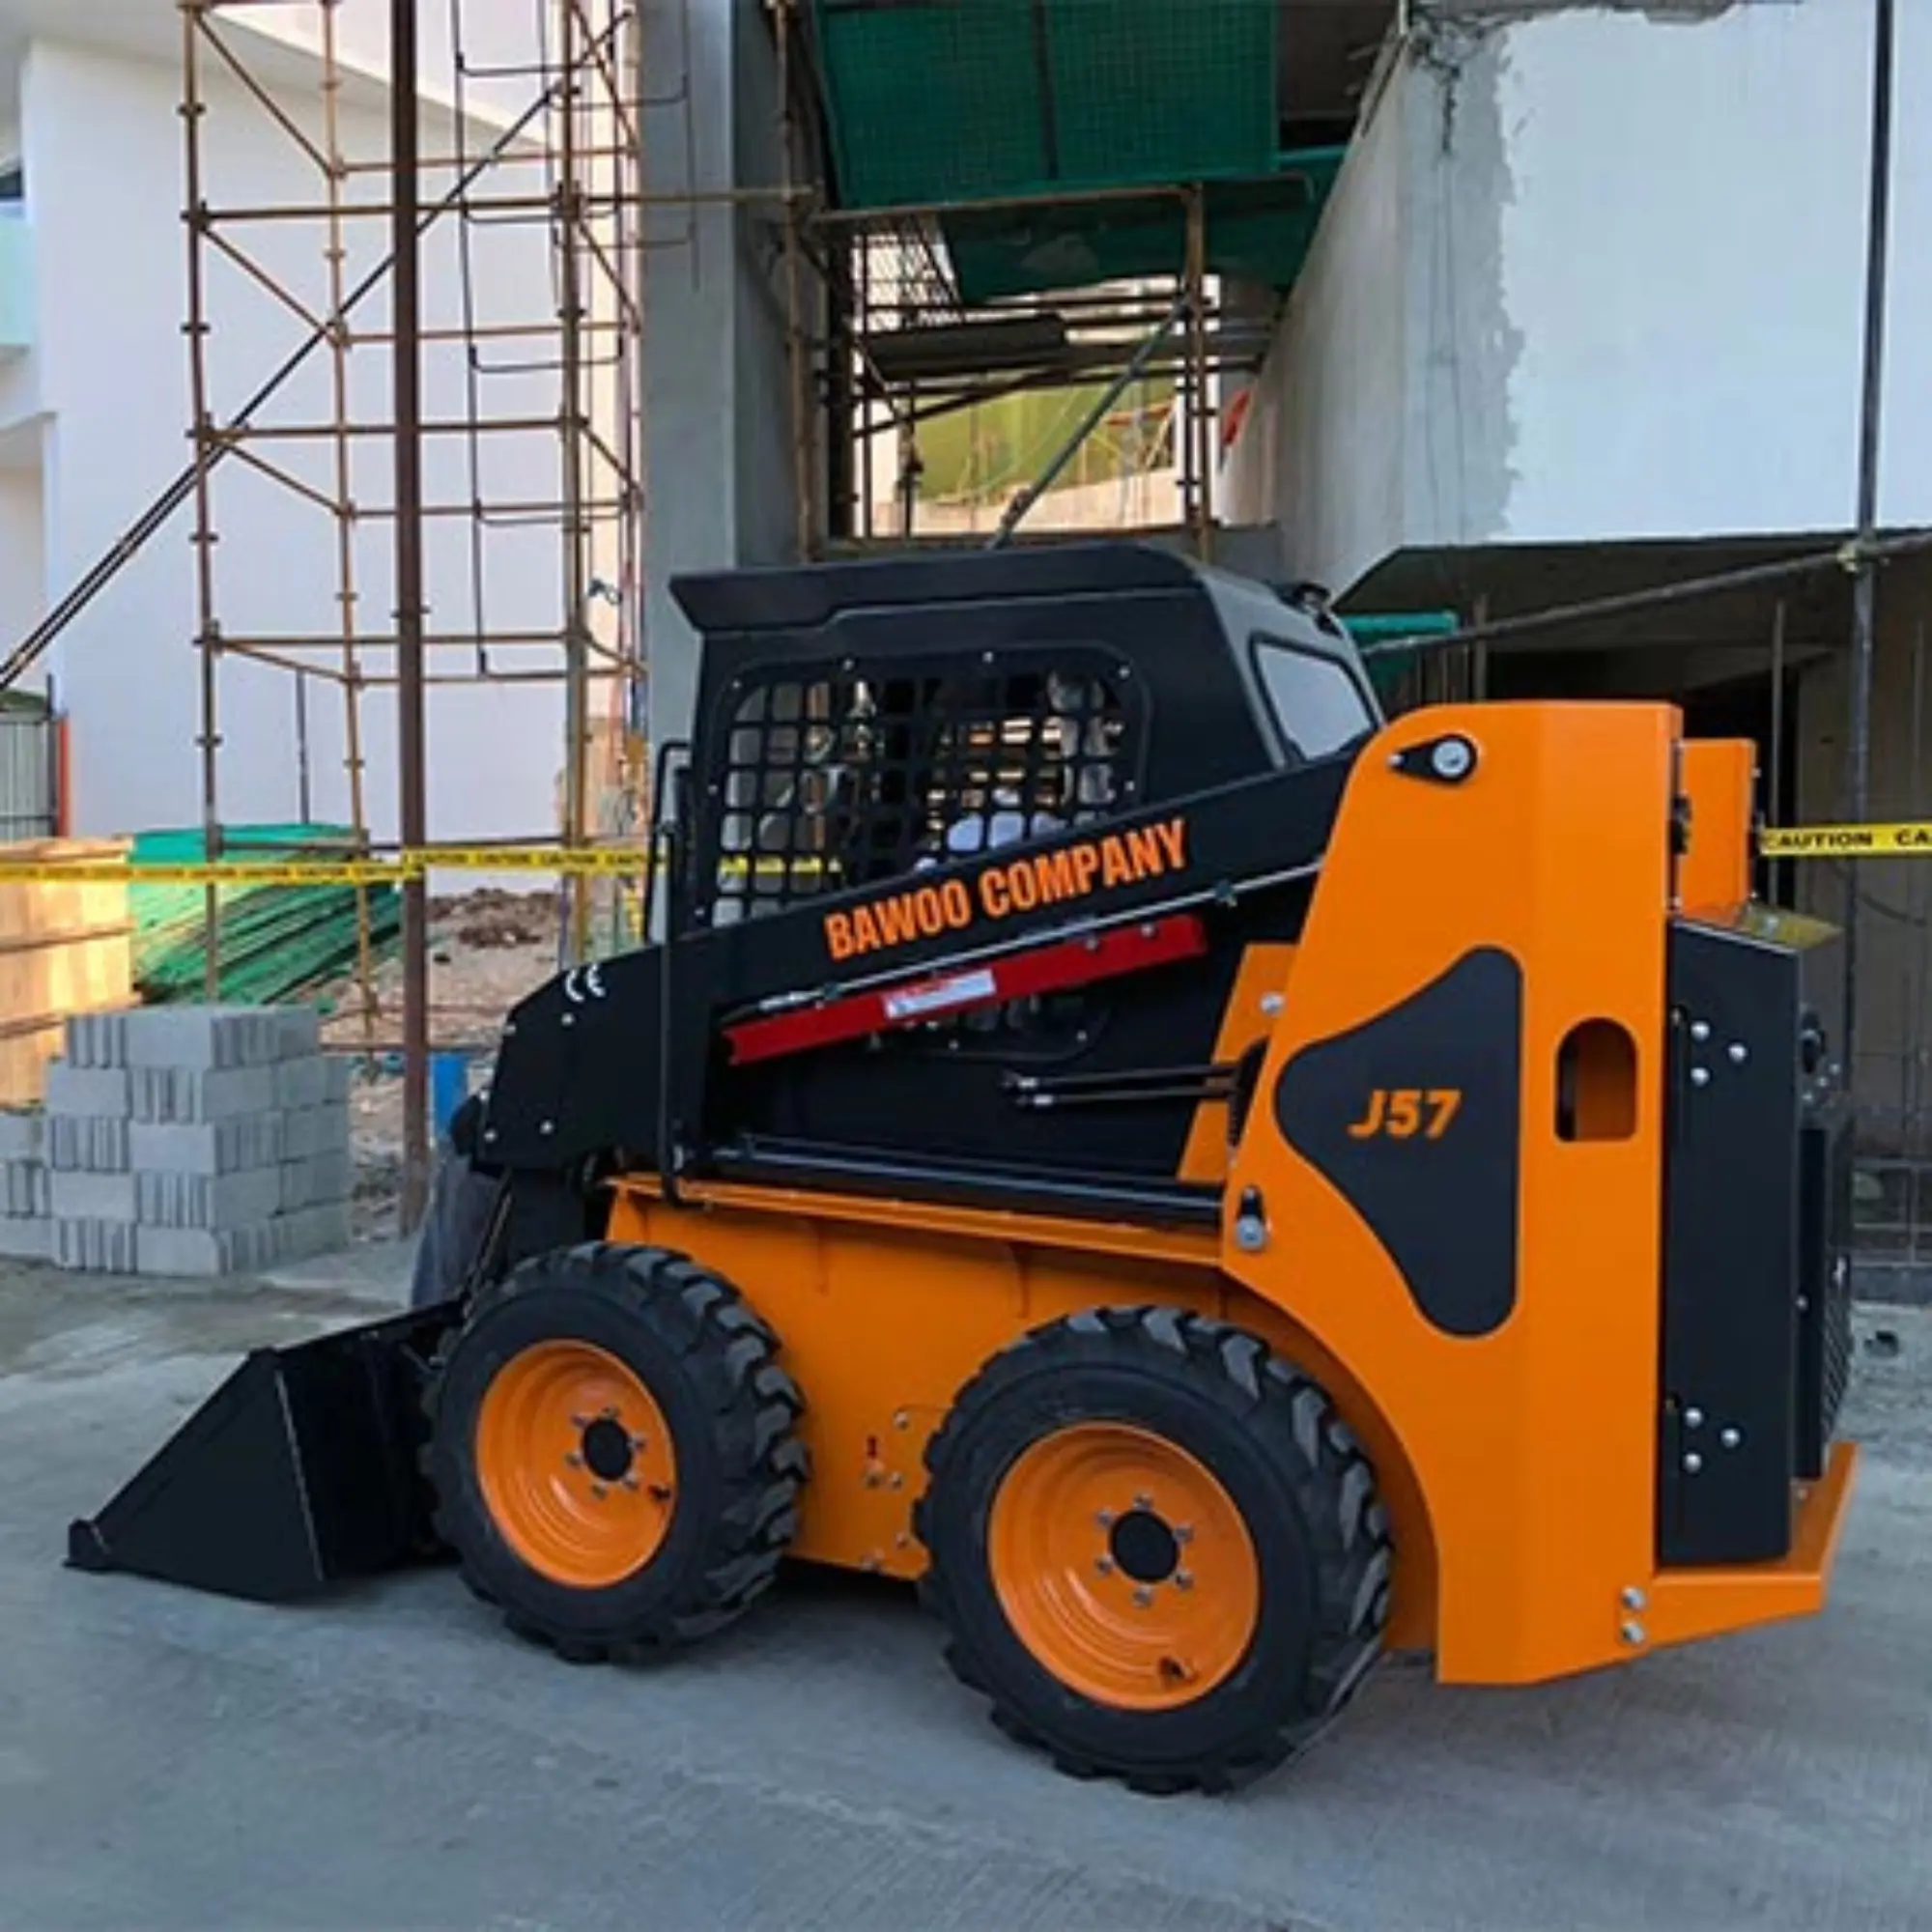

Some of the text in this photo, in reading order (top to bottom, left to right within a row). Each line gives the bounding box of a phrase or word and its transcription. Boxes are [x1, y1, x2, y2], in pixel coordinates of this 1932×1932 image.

[824, 818, 1187, 961] BAWOO COMPANY
[1347, 1088, 1463, 1139] J57
